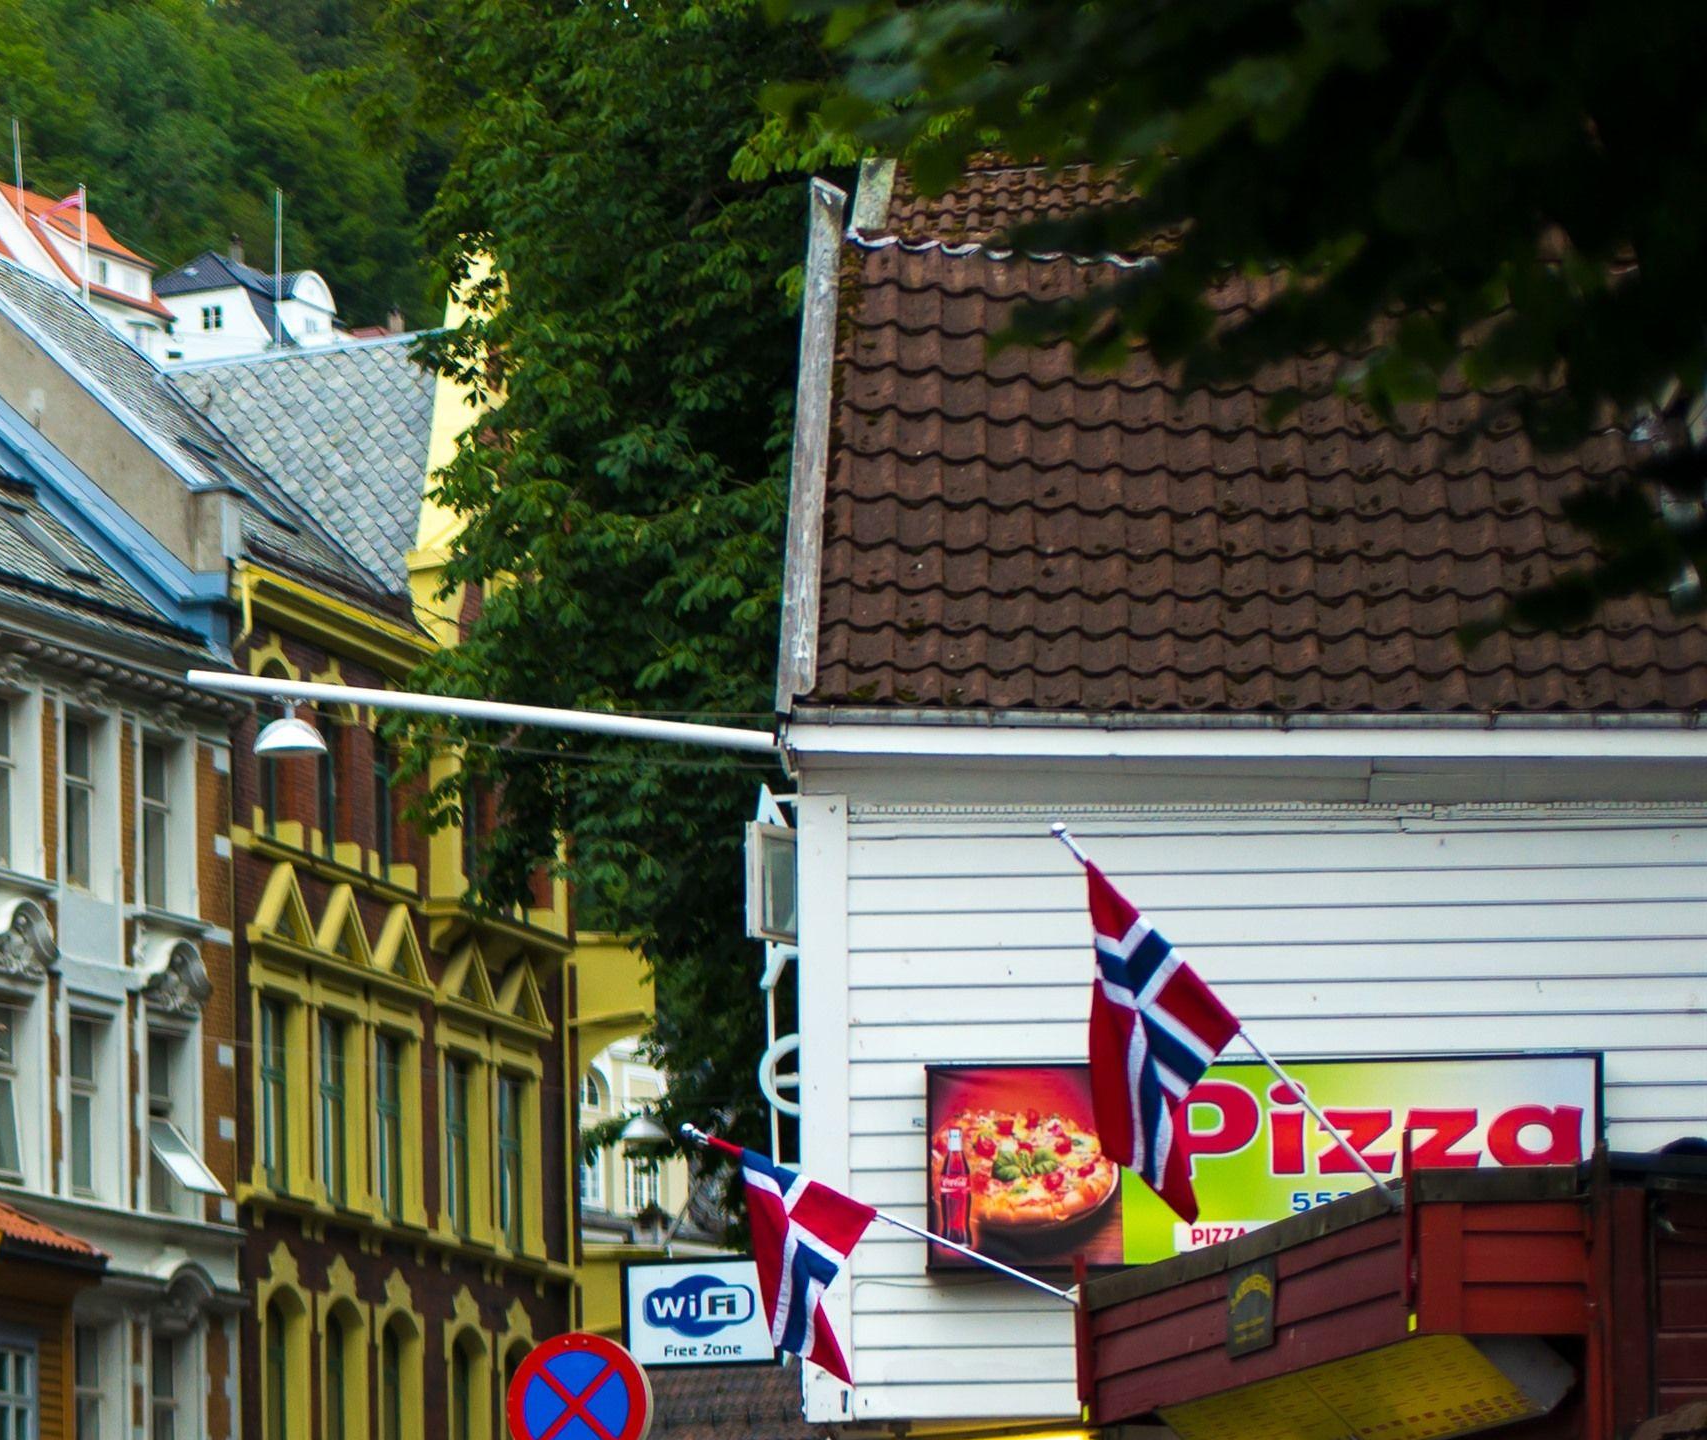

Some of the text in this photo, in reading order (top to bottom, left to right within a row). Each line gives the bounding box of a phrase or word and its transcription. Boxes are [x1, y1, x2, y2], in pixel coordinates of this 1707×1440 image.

[1177, 1077, 1584, 1178] Pizza
[664, 1343, 743, 1358] Free Zone
